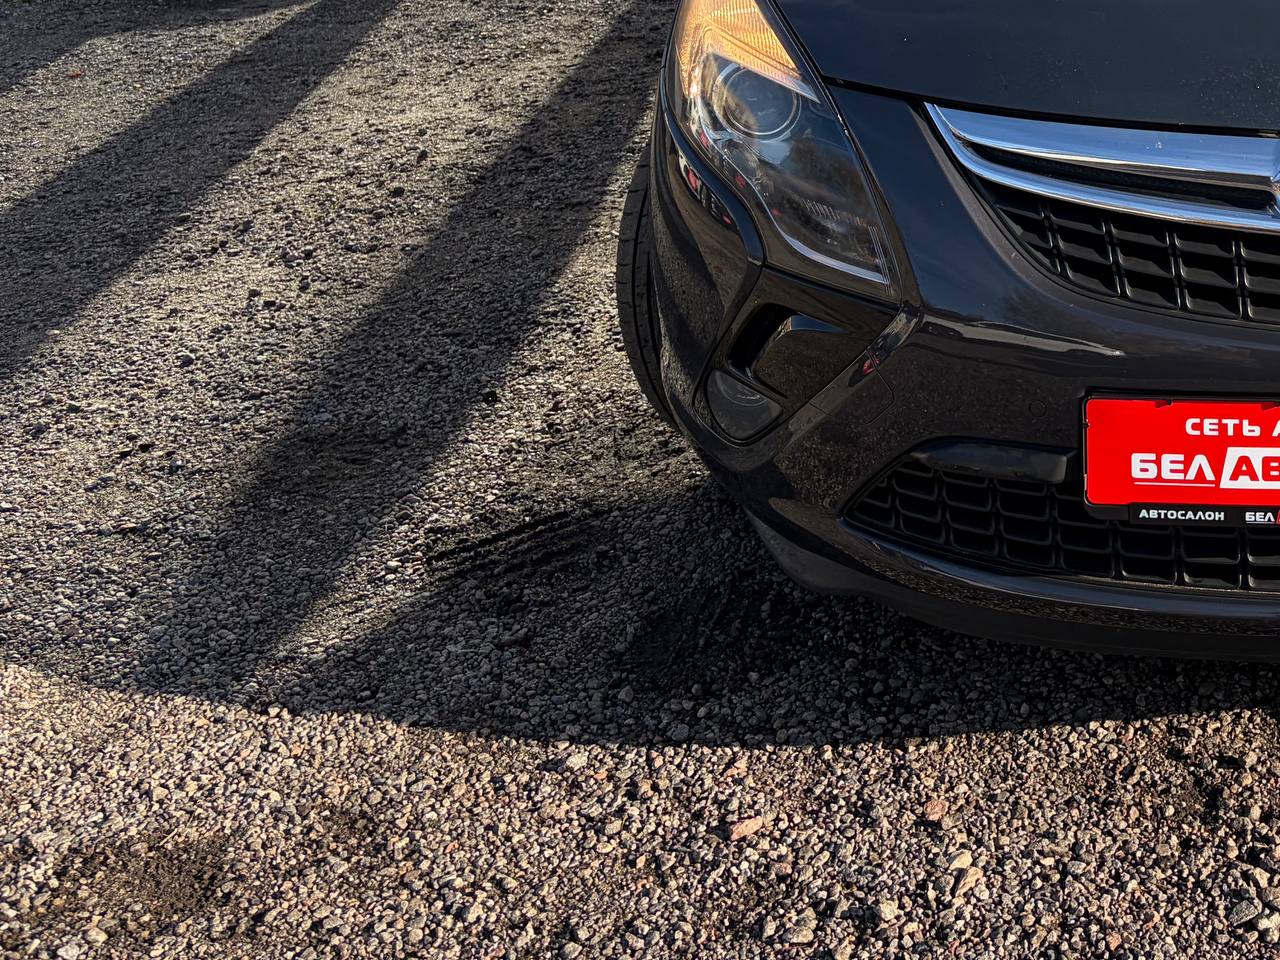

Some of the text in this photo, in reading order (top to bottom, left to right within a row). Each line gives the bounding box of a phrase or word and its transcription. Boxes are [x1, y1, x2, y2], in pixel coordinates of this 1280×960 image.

[1185, 418, 1261, 437] СЕТЬ
[1131, 453, 1216, 481] БЕЛ
[1139, 509, 1225, 521] АВТОСАЛОН
[1245, 511, 1275, 522] БЕЛ
